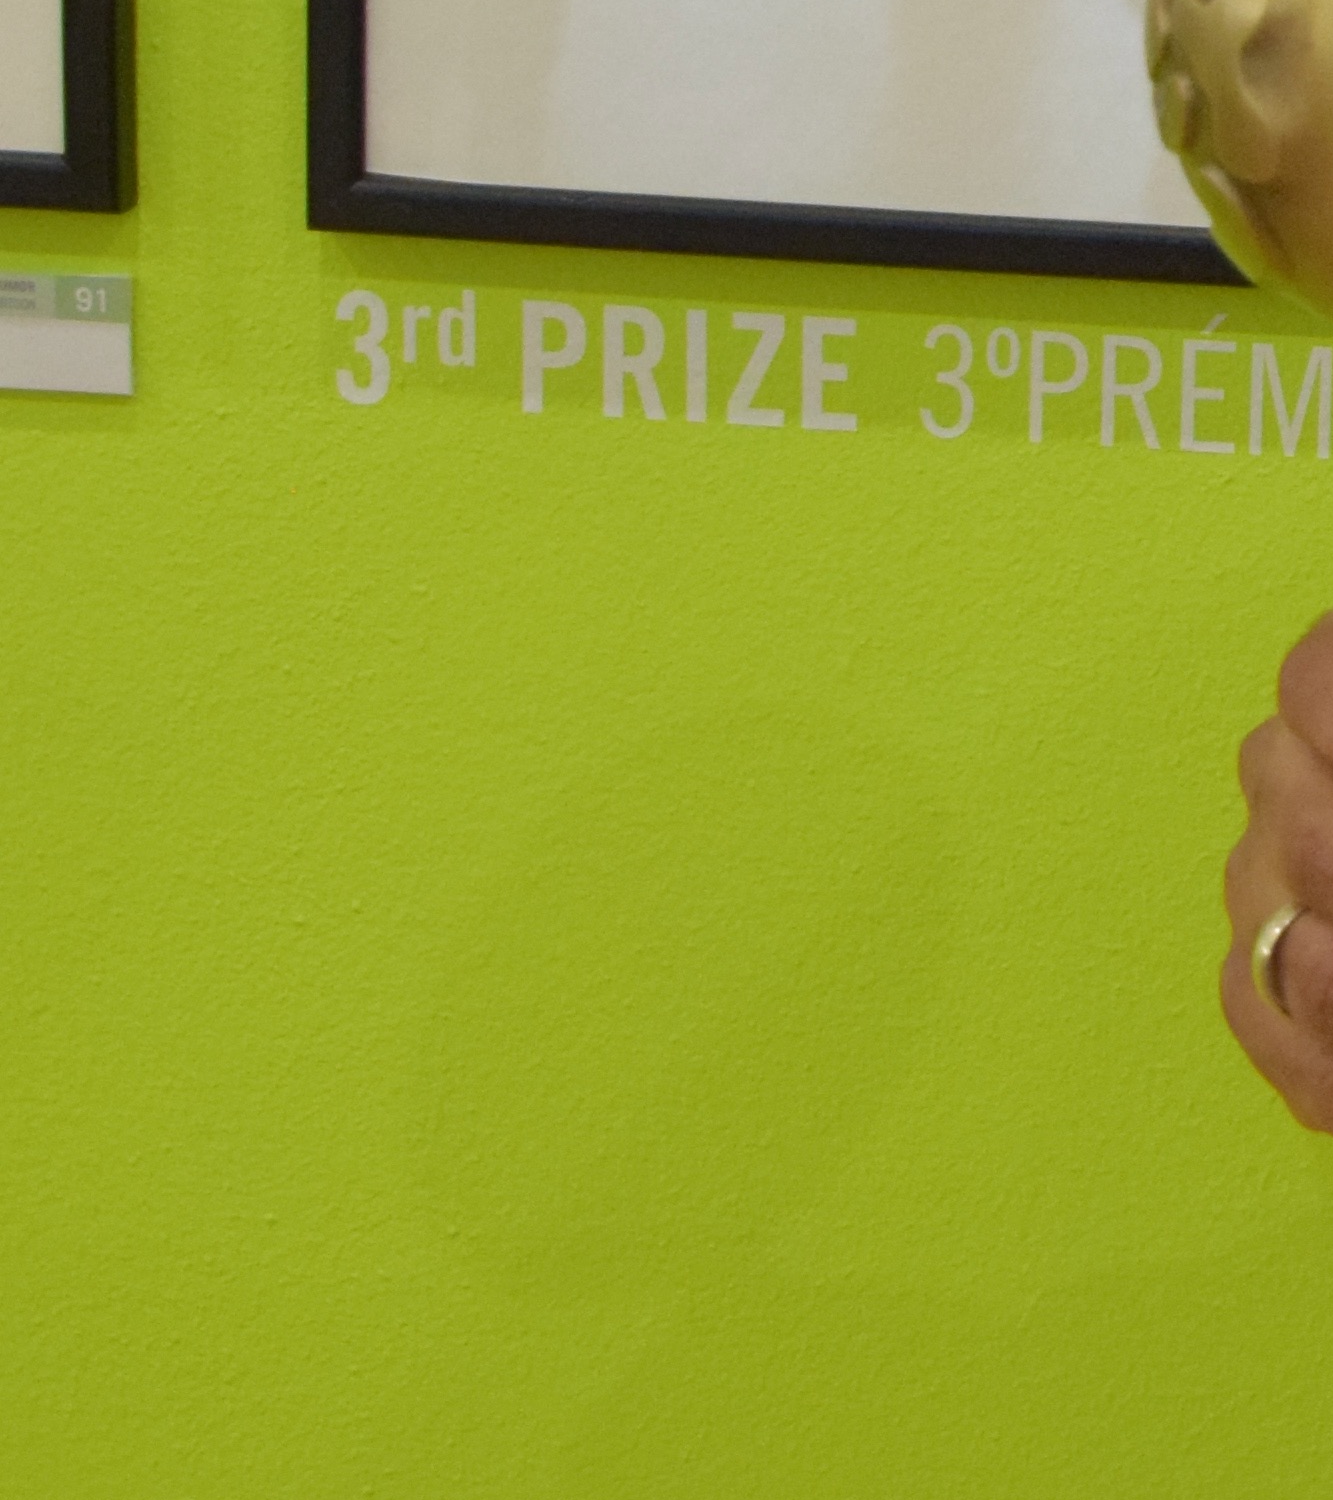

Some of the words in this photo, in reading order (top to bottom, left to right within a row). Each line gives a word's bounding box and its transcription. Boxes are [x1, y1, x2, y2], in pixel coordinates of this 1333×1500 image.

[75, 285, 108, 312] 91
[335, 289, 476, 406] 3rd
[521, 299, 858, 432] PRIZE
